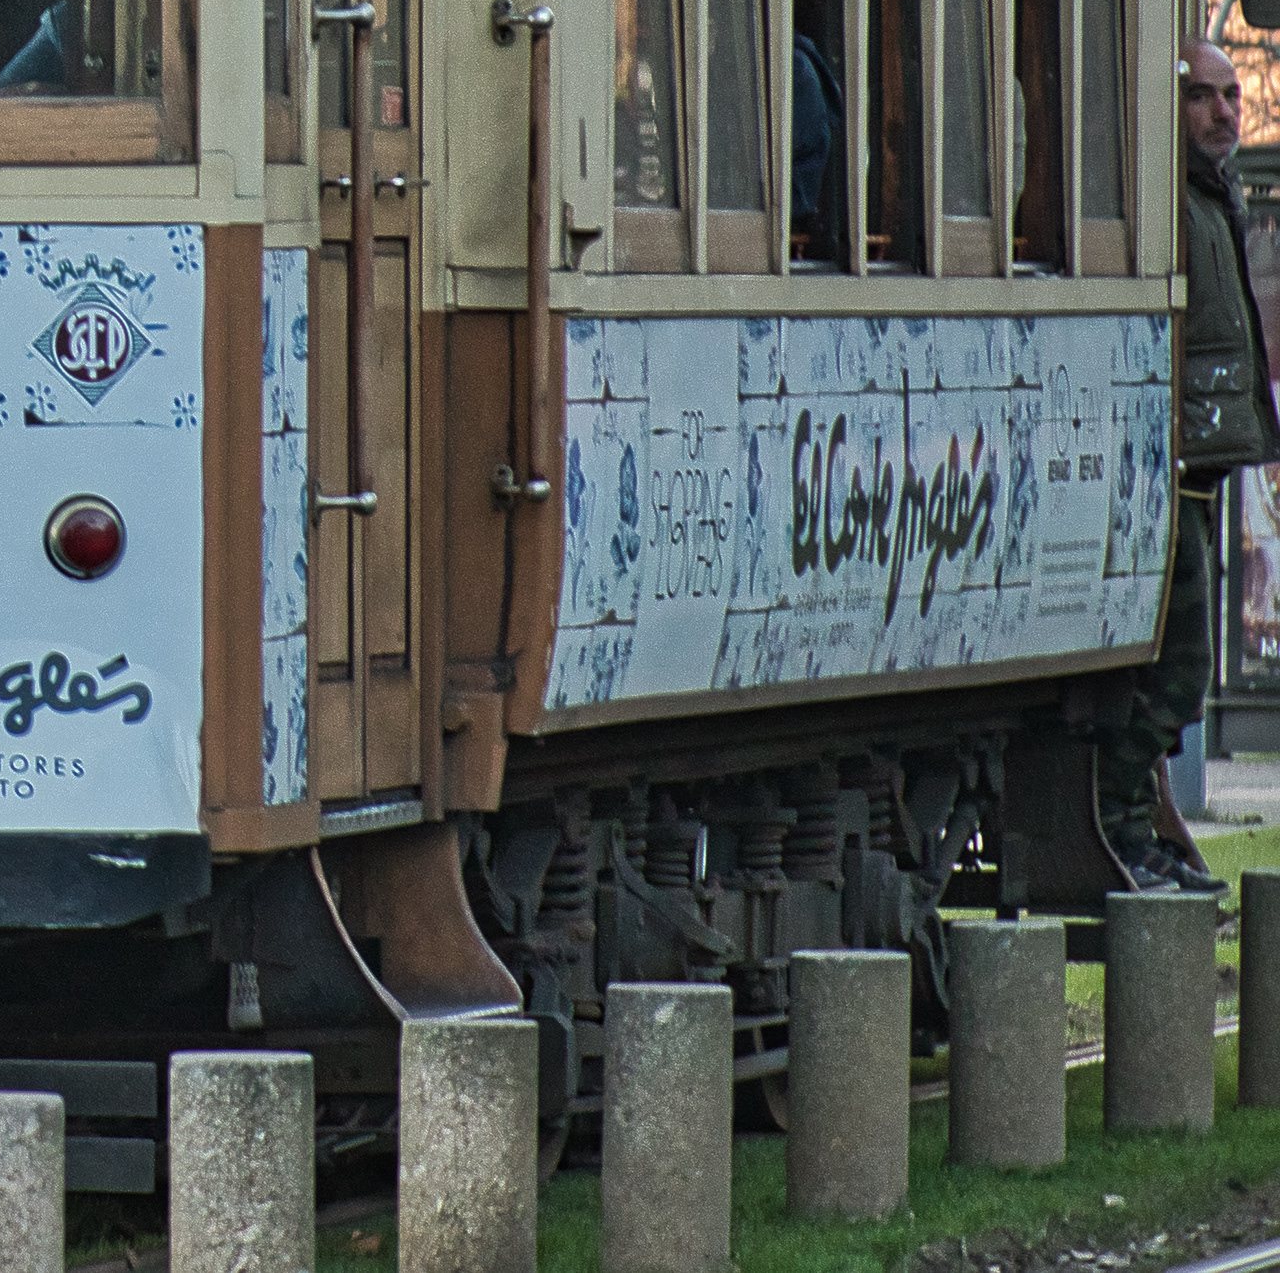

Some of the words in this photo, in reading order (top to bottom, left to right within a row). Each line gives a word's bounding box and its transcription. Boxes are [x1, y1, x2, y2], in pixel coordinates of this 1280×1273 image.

[681, 409, 706, 460] FOR
[792, 407, 821, 577] El
[823, 412, 894, 575] Corte
[884, 367, 994, 627] Inglés
